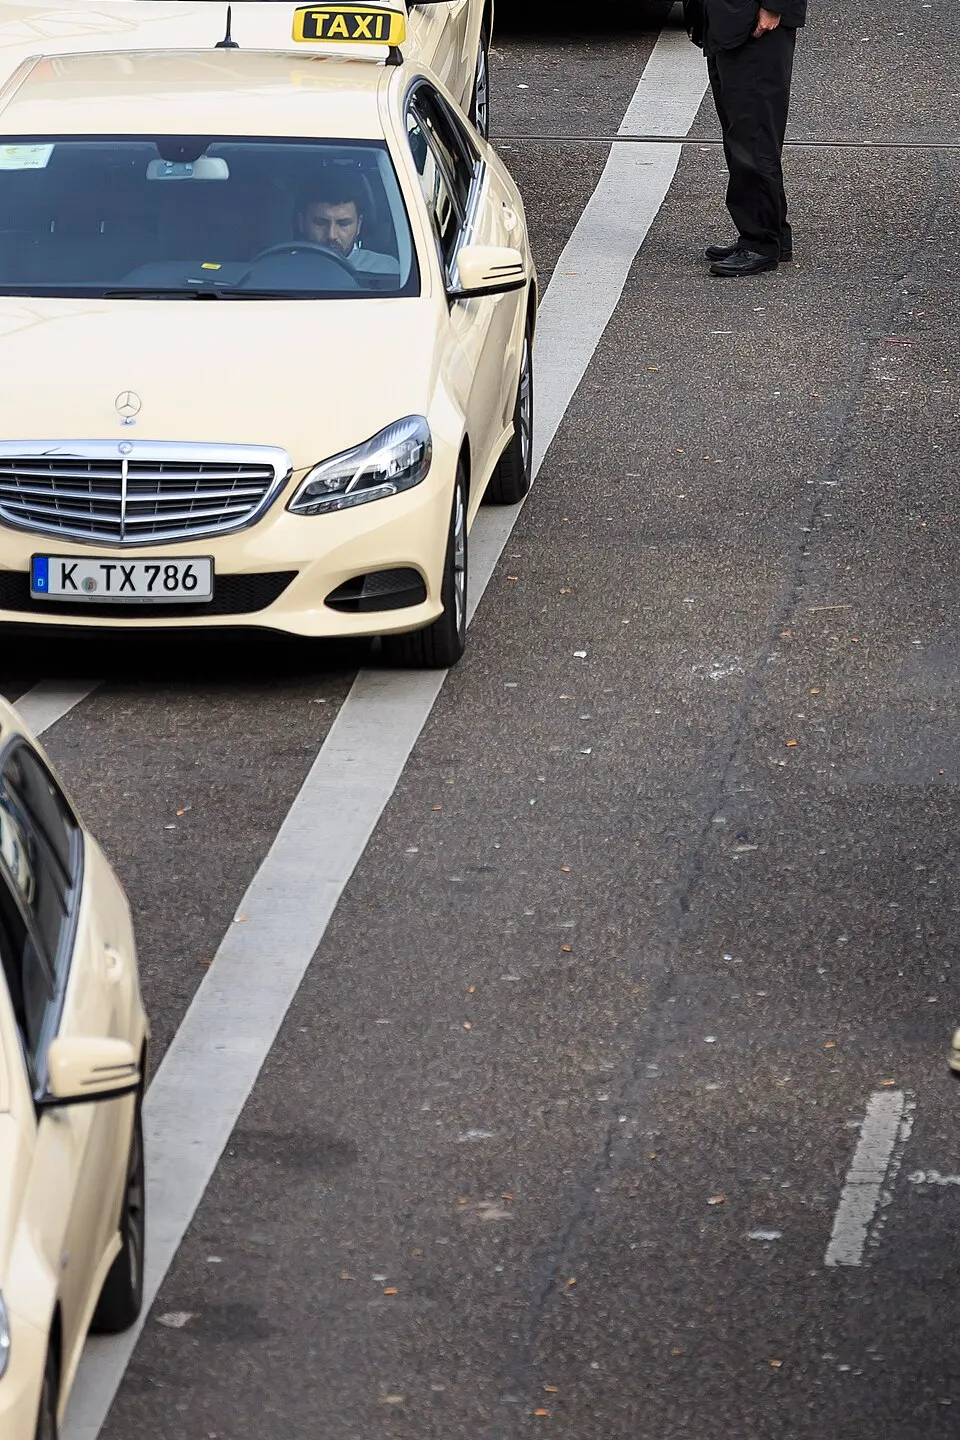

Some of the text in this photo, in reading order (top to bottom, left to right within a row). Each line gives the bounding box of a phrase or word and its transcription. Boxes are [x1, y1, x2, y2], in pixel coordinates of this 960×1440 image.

[312, 14, 383, 39] TAXI
[61, 563, 79, 591] K
[144, 564, 198, 592] 786
